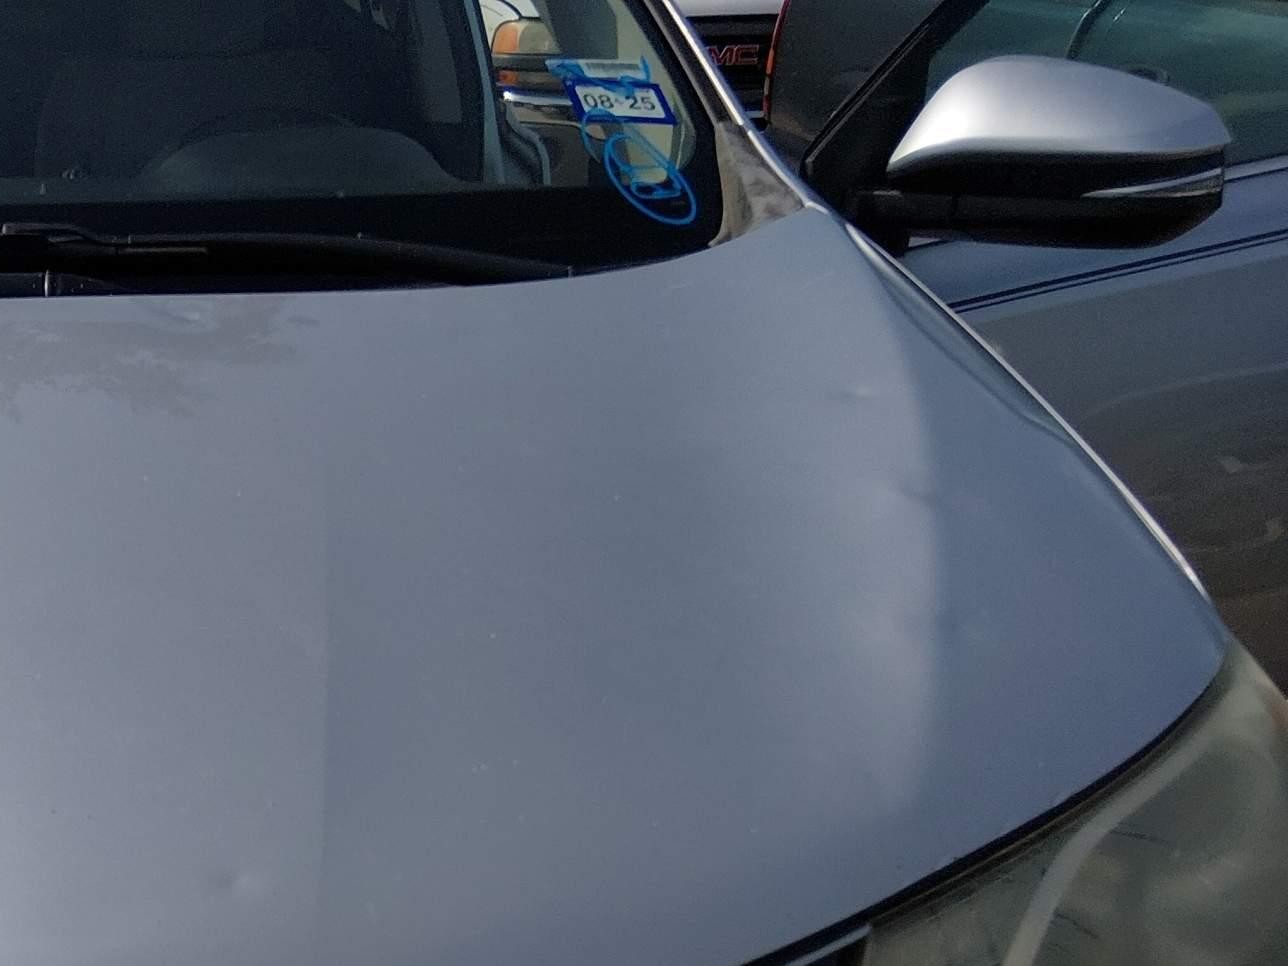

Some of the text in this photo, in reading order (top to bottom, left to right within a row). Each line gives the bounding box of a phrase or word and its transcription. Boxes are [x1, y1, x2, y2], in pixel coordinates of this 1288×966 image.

[705, 44, 760, 66] MC
[582, 93, 657, 112] 08 25
